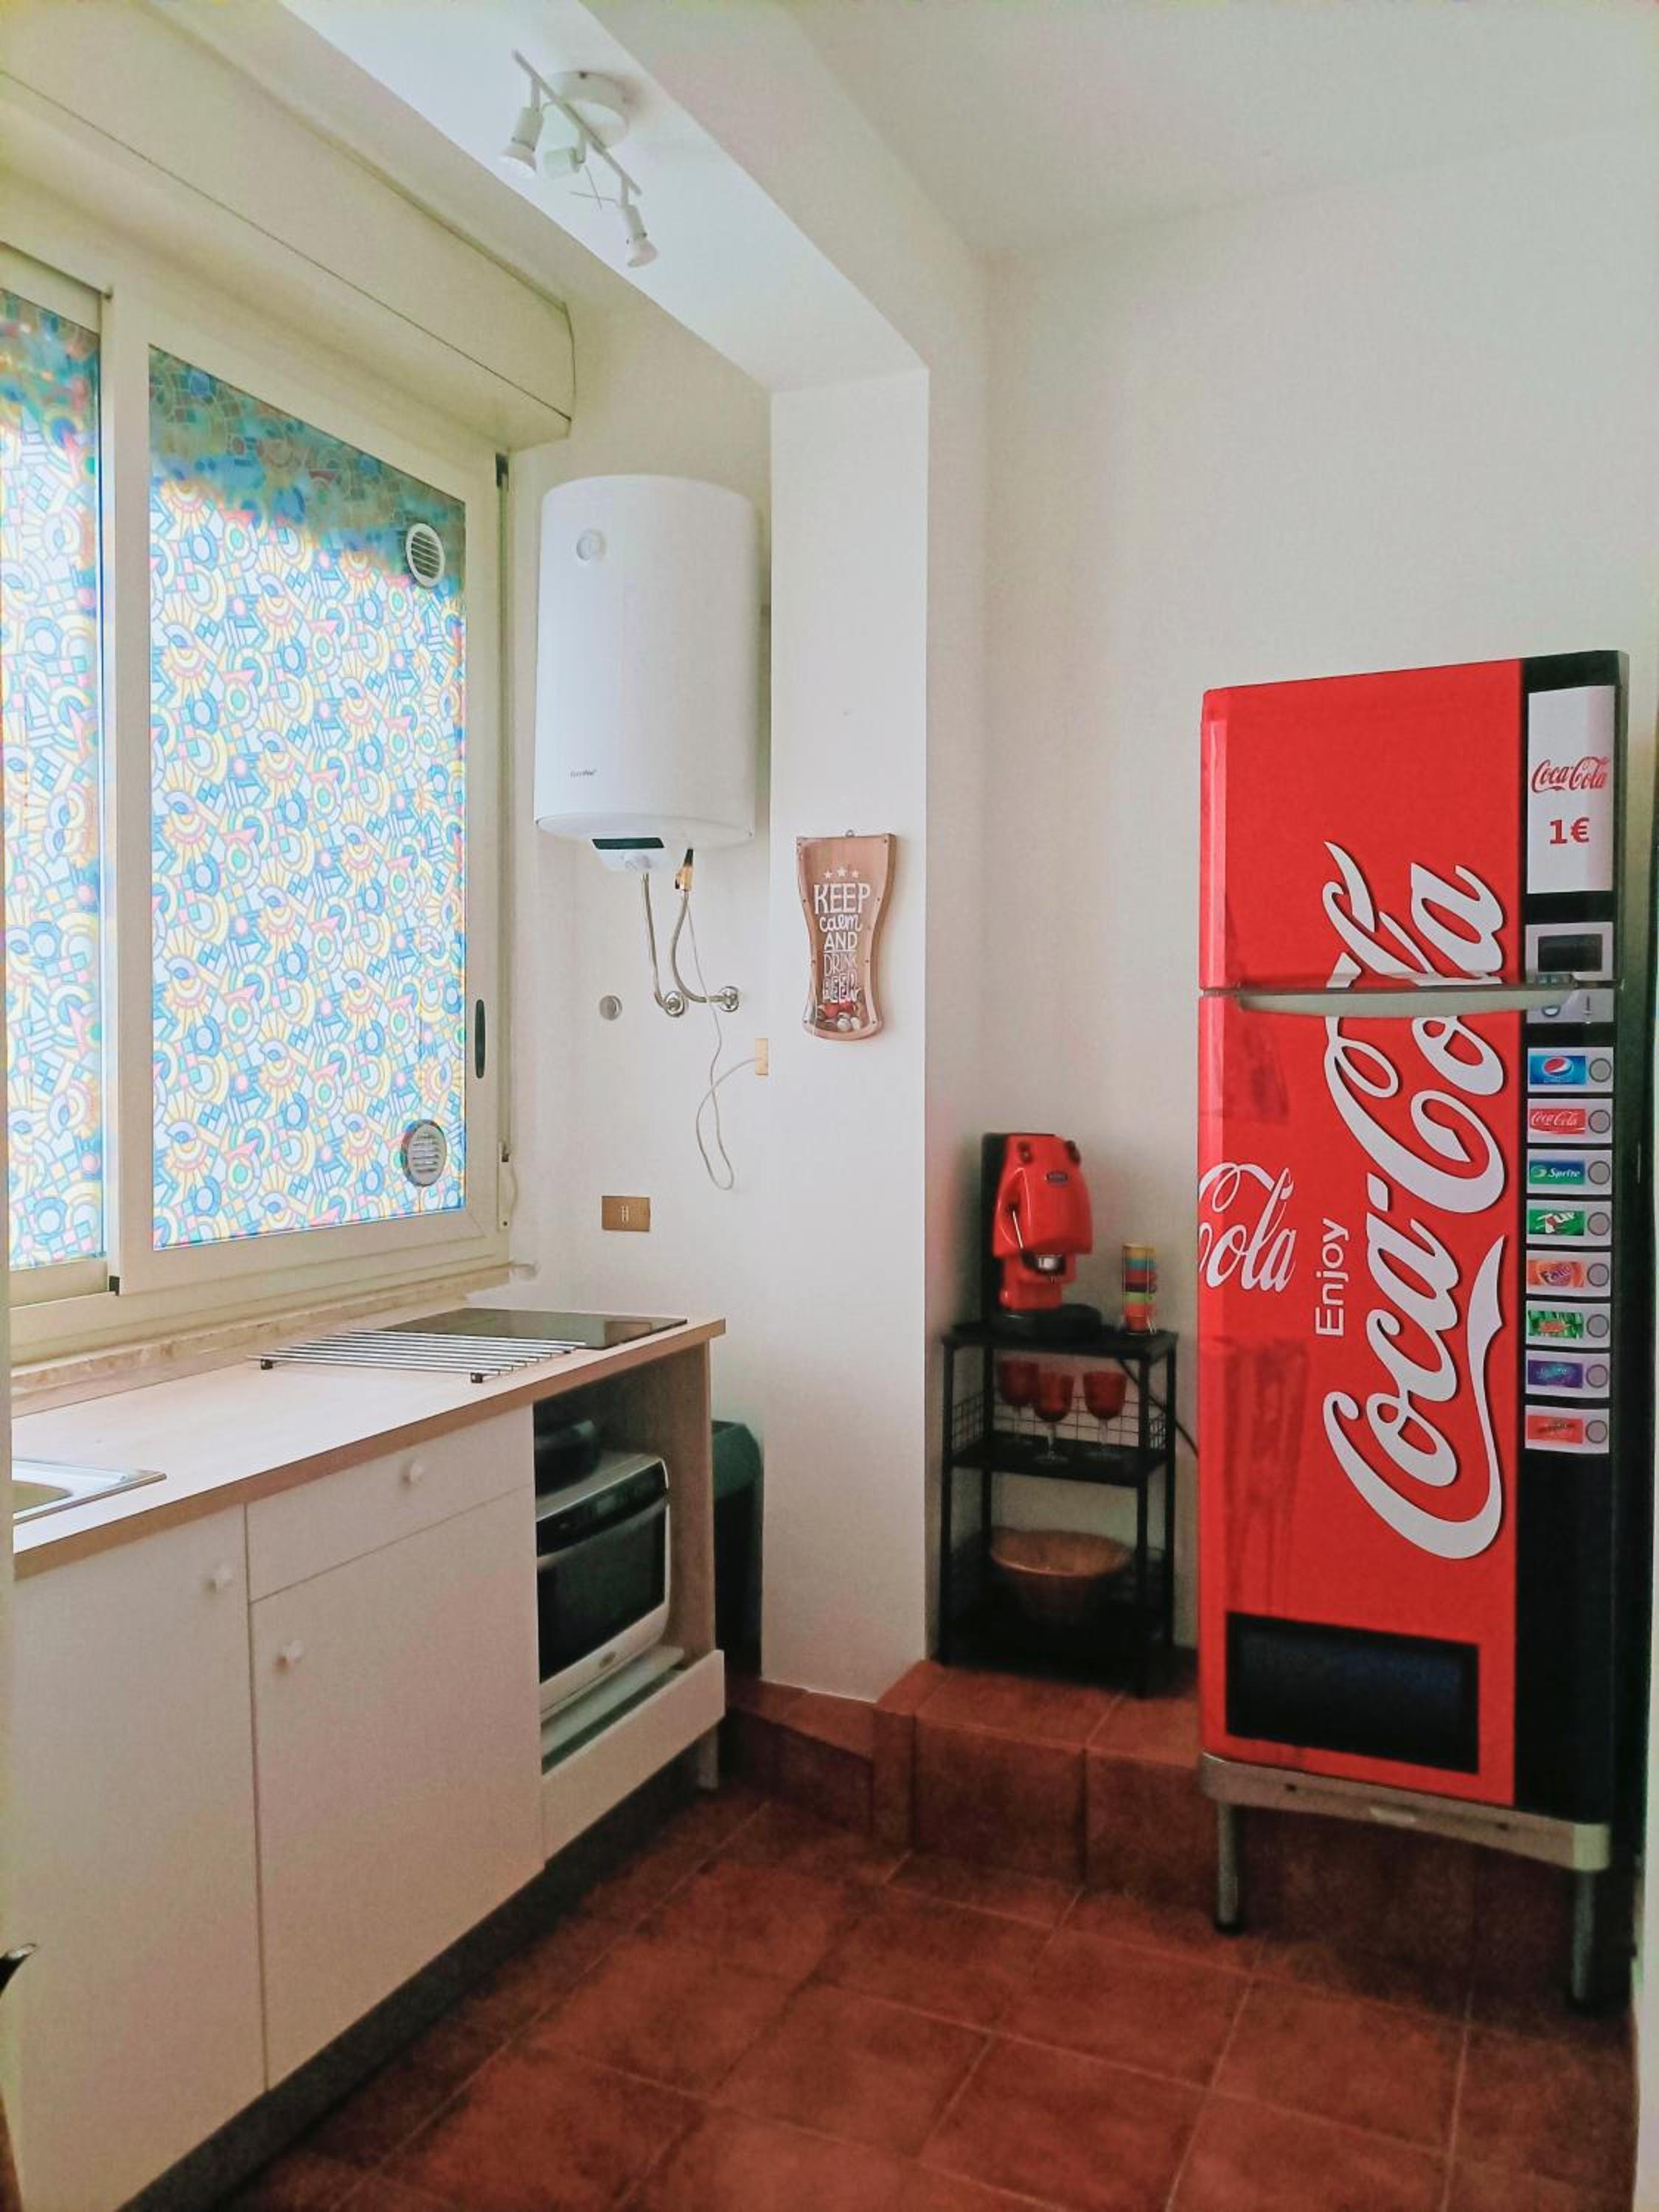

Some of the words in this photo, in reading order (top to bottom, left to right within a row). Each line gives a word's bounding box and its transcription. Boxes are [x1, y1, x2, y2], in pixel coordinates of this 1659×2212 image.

[1549, 817, 1590, 845] 1€
[813, 883, 871, 915] KEEP
[824, 932, 858, 951] AND
[823, 953, 858, 976] DRINK
[1548, 1167, 1581, 1179] Sprite
[1315, 1217, 1349, 1336] Enjoy
